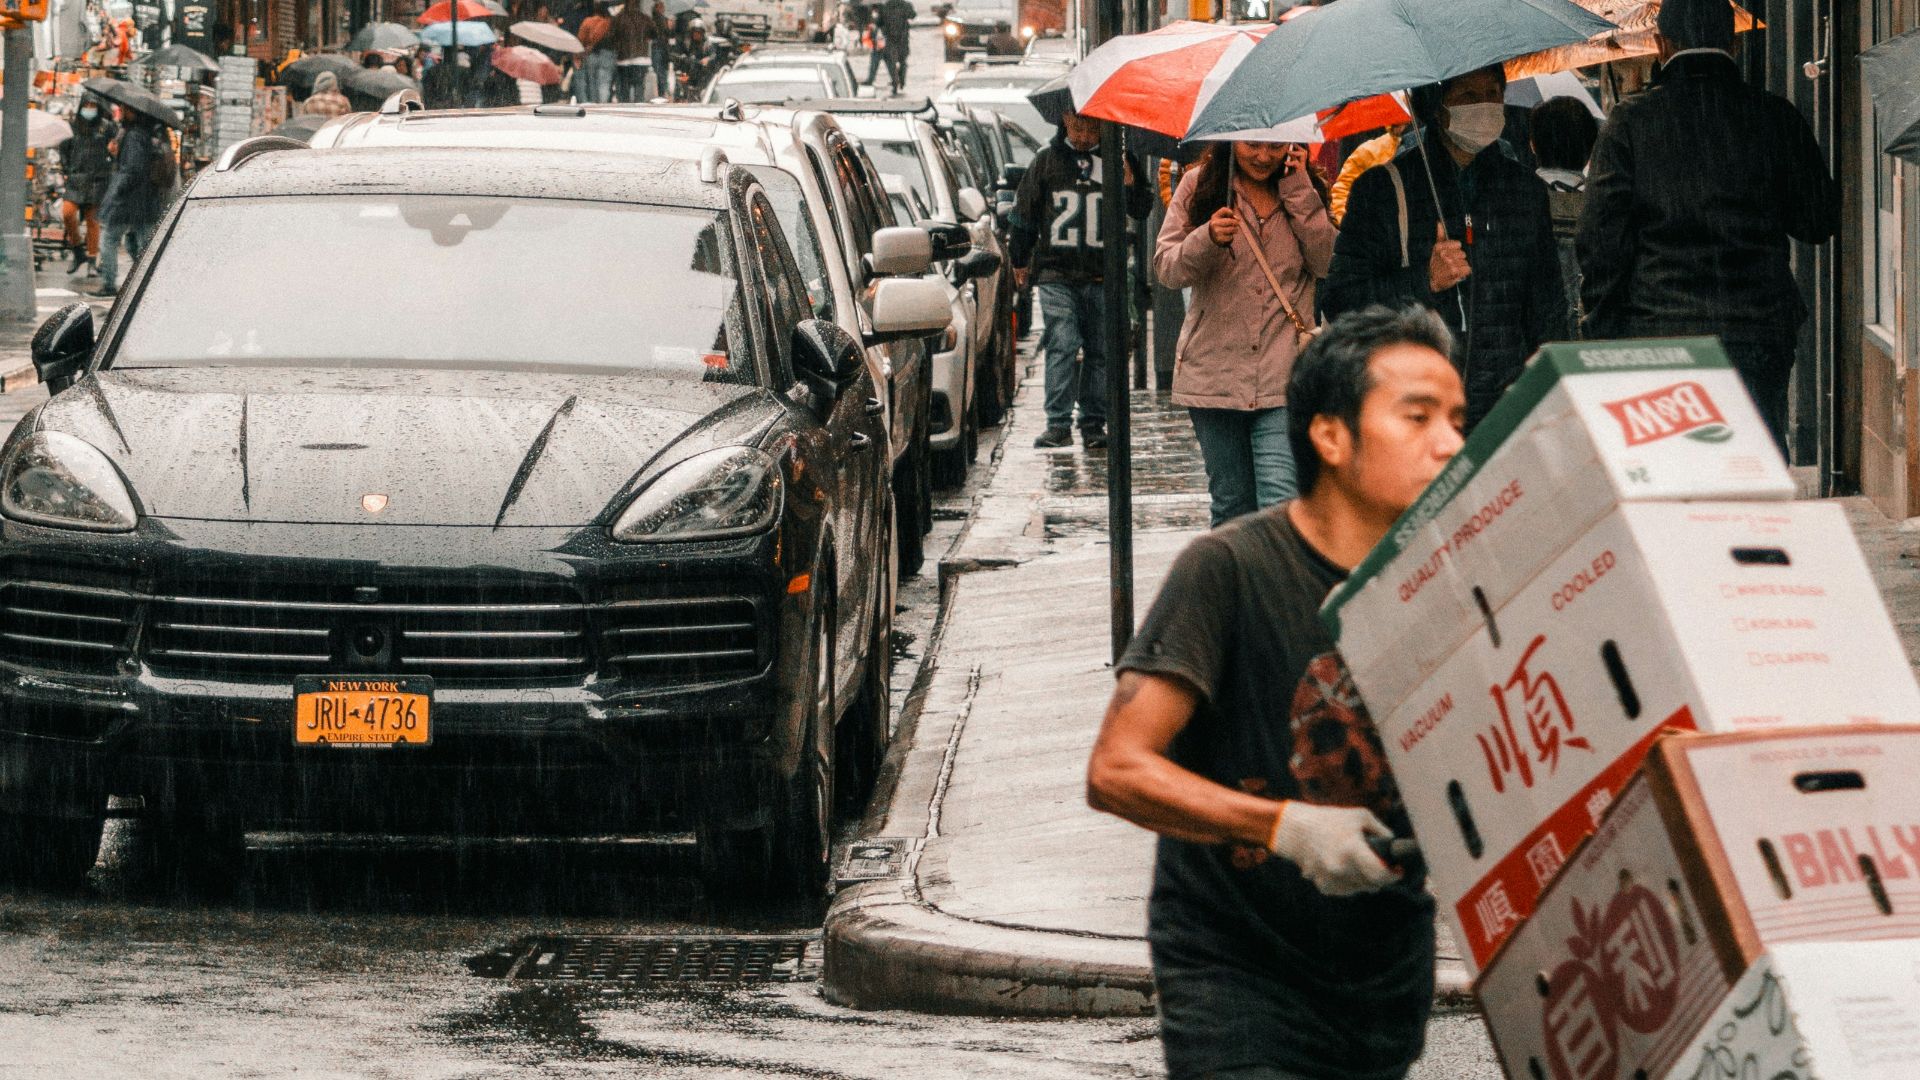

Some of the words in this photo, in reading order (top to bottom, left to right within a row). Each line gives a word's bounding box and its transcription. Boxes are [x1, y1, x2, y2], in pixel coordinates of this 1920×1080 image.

[1579, 347, 1695, 367] WATERCRESS
[1621, 383, 1714, 441] B&W
[1395, 455, 1475, 548] WATERCRESS
[1398, 540, 1452, 603] QUALITY
[1453, 478, 1524, 550] PRODUCE
[1551, 549, 1617, 612] COOLED
[329, 681, 361, 692] NEW
[364, 681, 398, 692] YORK
[363, 697, 417, 730] 4736
[327, 733, 364, 741] EMPIRE
[368, 733, 397, 741] STATE
[1399, 692, 1454, 753] VACUUM
[1780, 823, 1920, 889] BALLY
